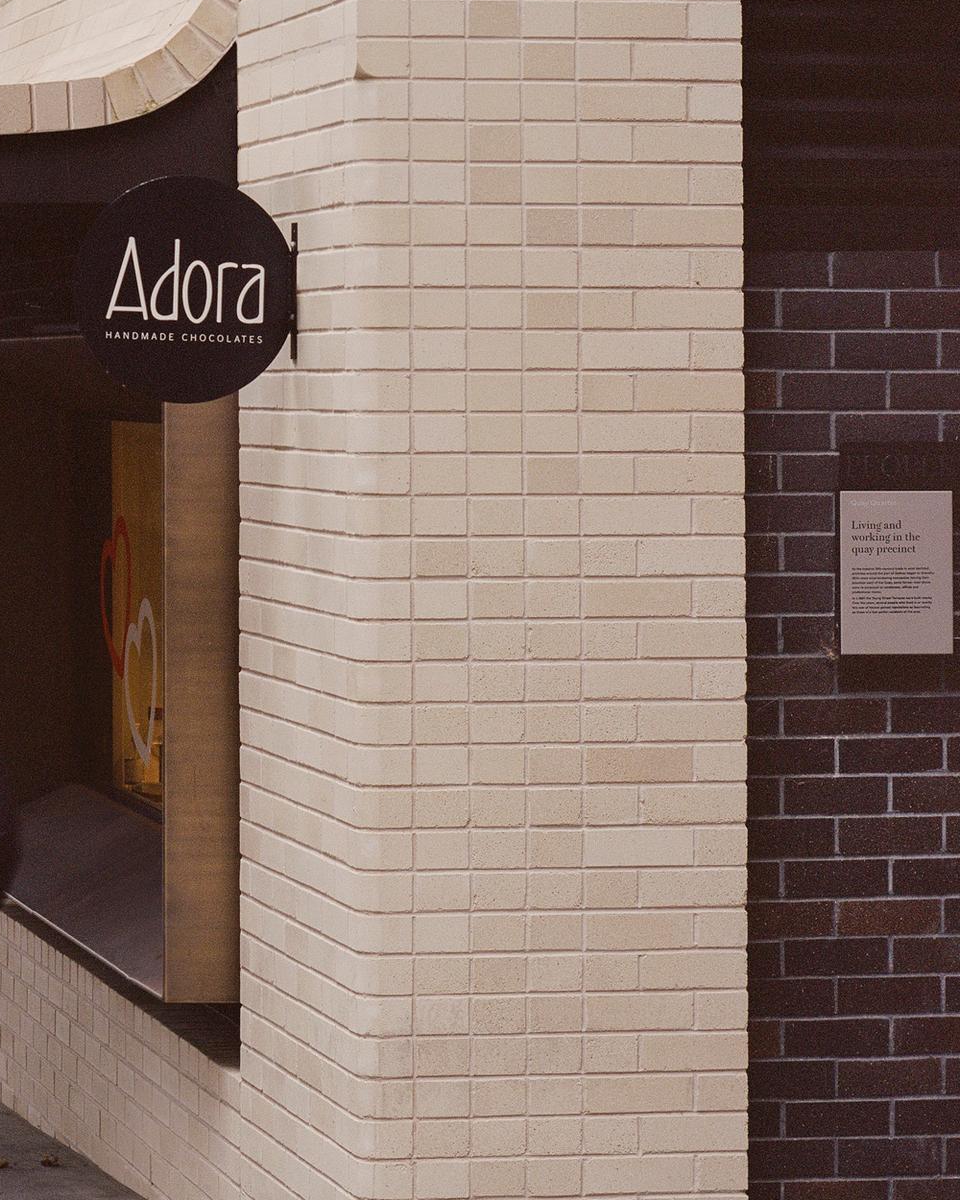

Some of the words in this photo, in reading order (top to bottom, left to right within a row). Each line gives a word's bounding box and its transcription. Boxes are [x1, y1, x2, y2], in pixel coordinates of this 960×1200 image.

[105, 236, 265, 325] Adora
[105, 330, 175, 342] HANDMADE
[181, 332, 263, 344] CHOCOLATES
[851, 520, 882, 532] Living
[883, 520, 902, 530] and
[851, 532, 891, 543] working
[892, 532, 903, 542] in
[905, 532, 921, 542] the
[851, 545, 875, 556] quay
[876, 544, 917, 556] precinct
